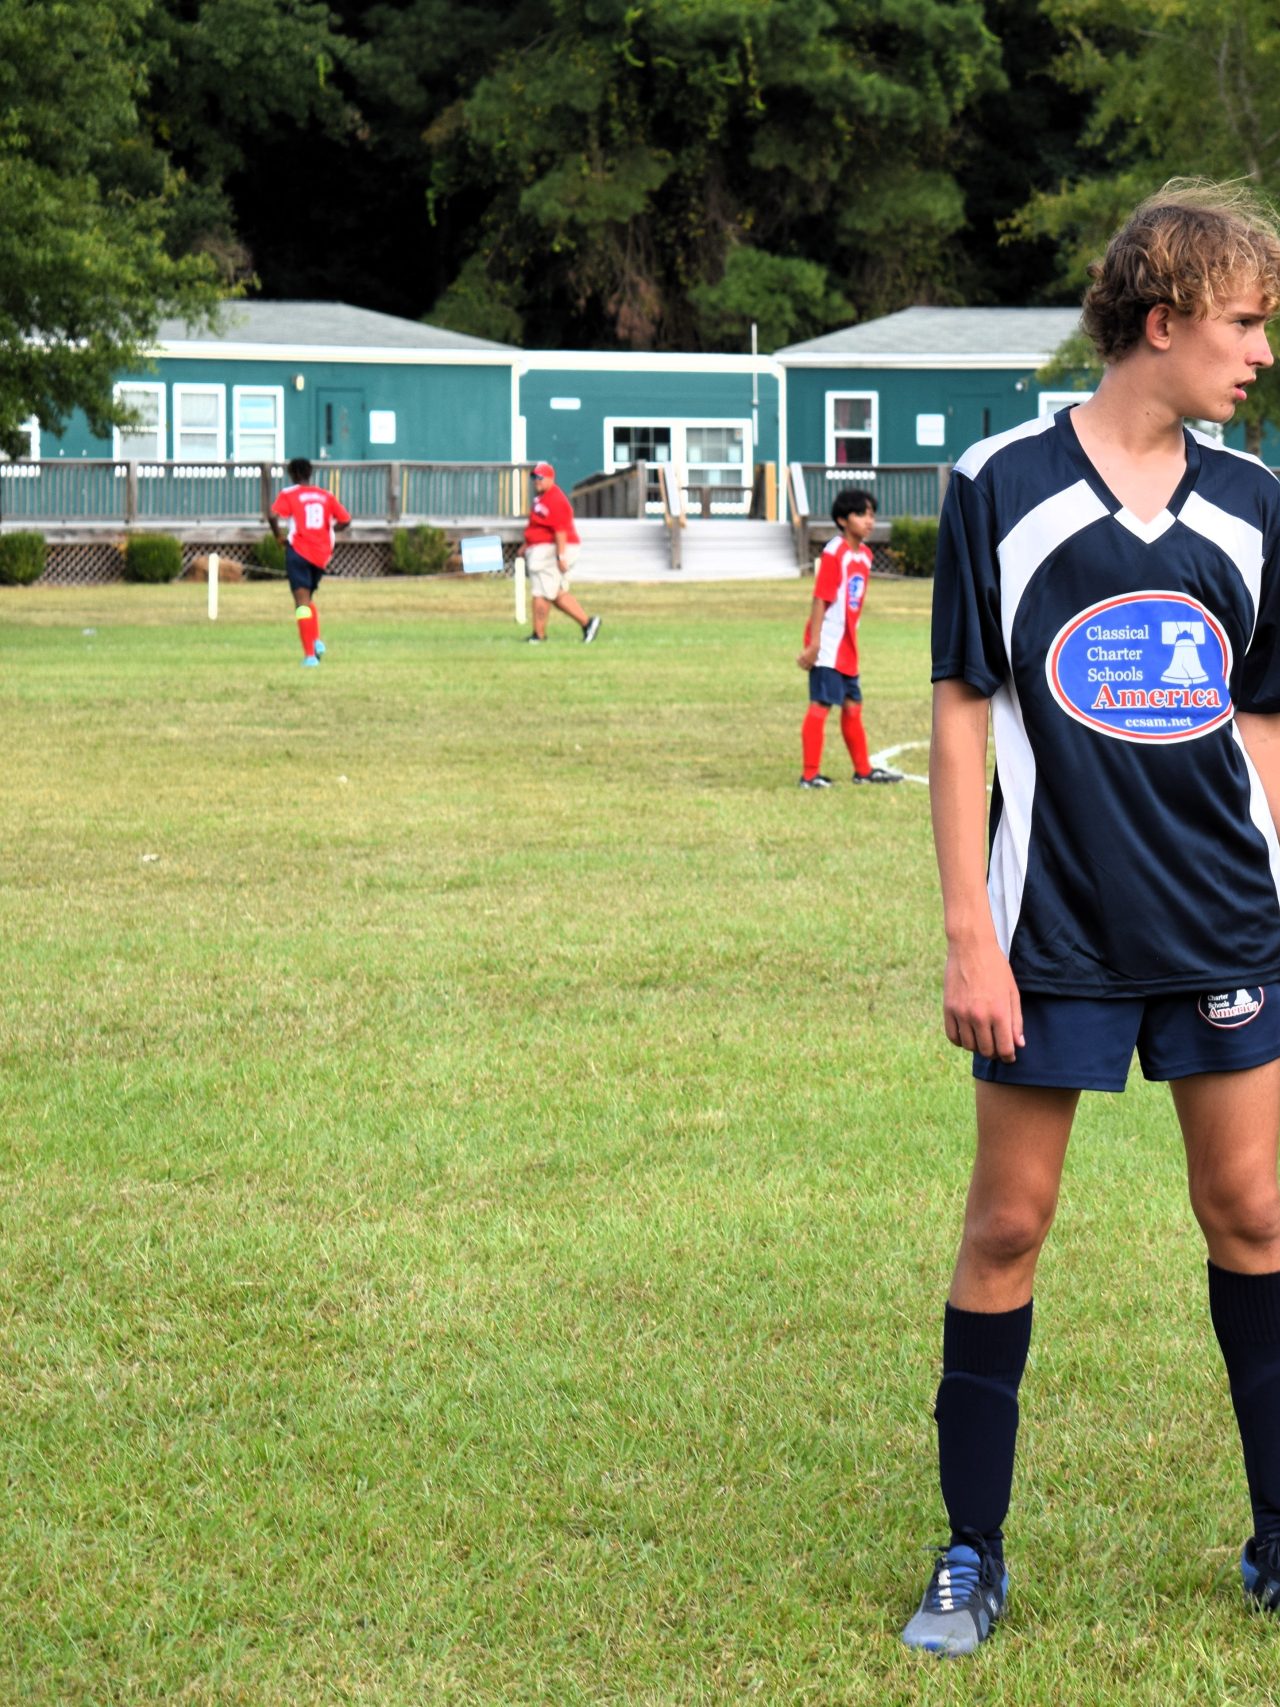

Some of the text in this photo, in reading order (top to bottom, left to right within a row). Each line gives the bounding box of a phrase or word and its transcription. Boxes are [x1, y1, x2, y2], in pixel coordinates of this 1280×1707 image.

[1086, 625, 1150, 641] Classical
[1086, 646, 1143, 662] Charter
[1087, 666, 1144, 683] Schools
[1091, 683, 1222, 710] America
[1125, 716, 1193, 728] ccsam.net
